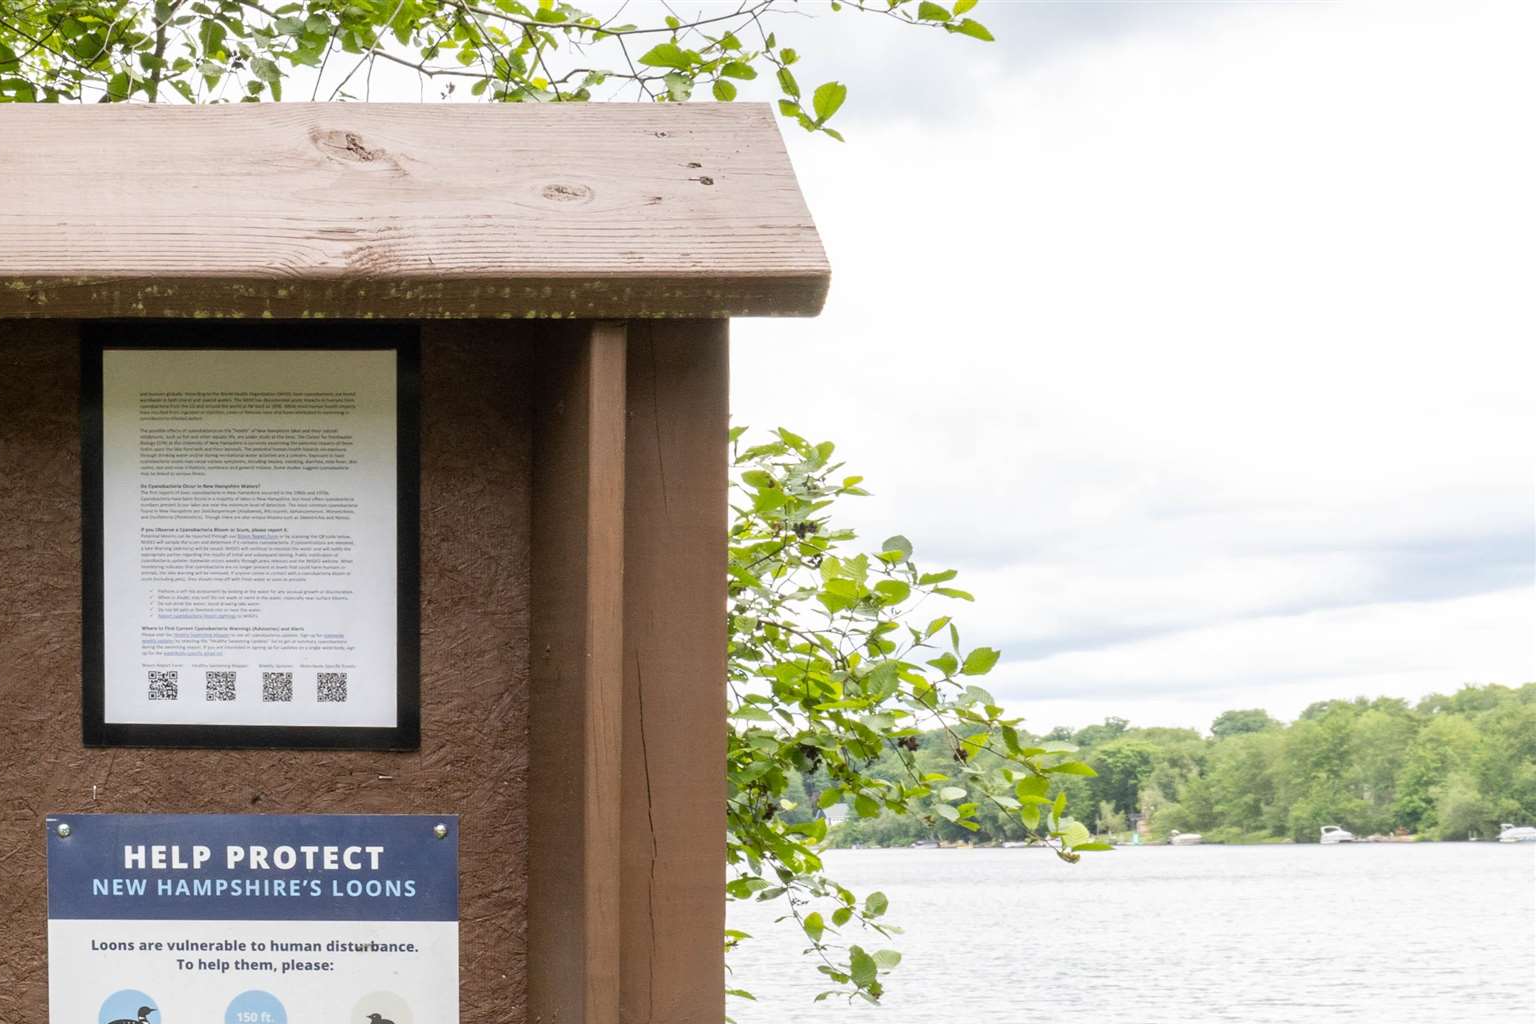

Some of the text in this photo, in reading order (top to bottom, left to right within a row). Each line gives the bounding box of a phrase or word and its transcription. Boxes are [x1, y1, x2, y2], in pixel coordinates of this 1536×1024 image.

[125, 846, 384, 870] HELP PROTECT
[94, 879, 146, 895] NEW
[333, 880, 416, 896] LOONS
[92, 939, 419, 951] Loons are vulnerable to human disturbance.
[177, 958, 334, 973] To help them, please:
[237, 1012, 276, 1023] 150 ft.
